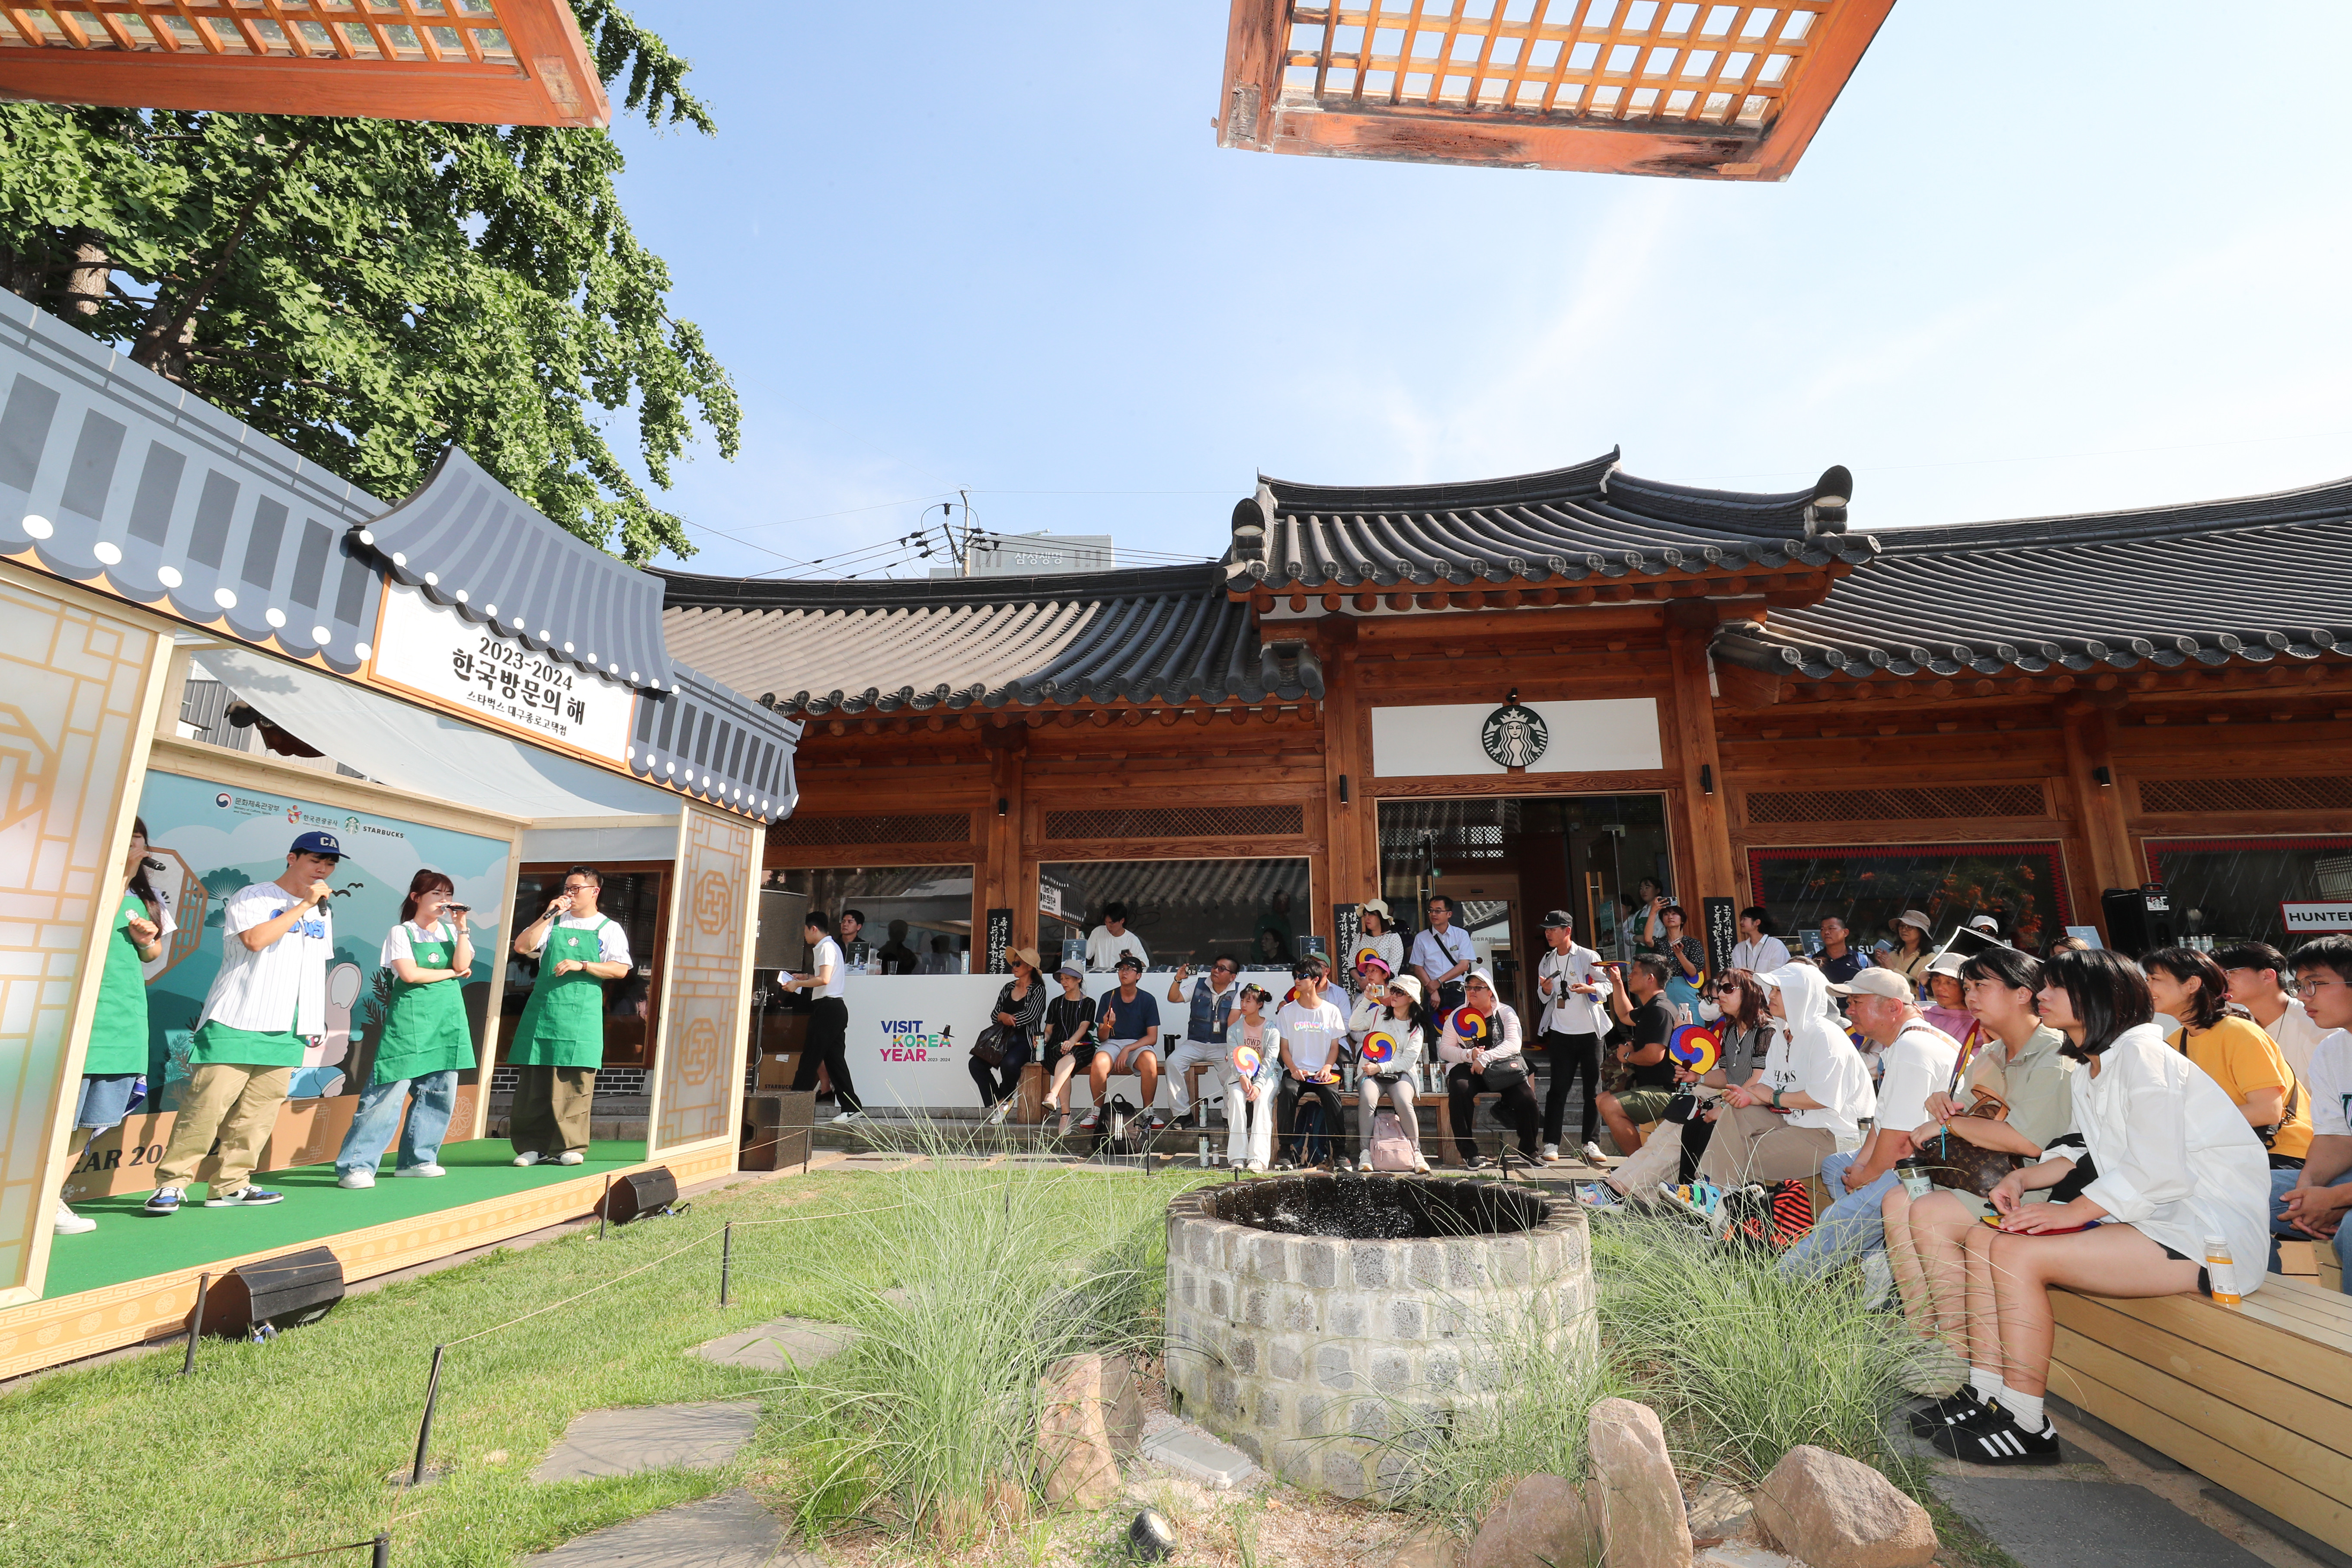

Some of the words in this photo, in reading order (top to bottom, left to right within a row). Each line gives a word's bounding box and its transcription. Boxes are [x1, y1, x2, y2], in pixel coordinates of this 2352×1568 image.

[1014, 552, 1062, 565] 삼성생명
[479, 637, 573, 691] 2023-2024
[453, 648, 561, 716] 한국방문의
[567, 697, 585, 725] 해
[467, 691, 505, 712] 스타벅스
[508, 706, 567, 736] 대구종로고택점
[235, 797, 280, 812] 문화체육관광부
[304, 814, 338, 826] 한국관광공사
[363, 826, 404, 838] STARBUCKS
[320, 837, 338, 848] CA
[881, 1021, 923, 1033] VISIT
[892, 1035, 952, 1047] KOREA
[879, 1049, 927, 1062] YEAR
